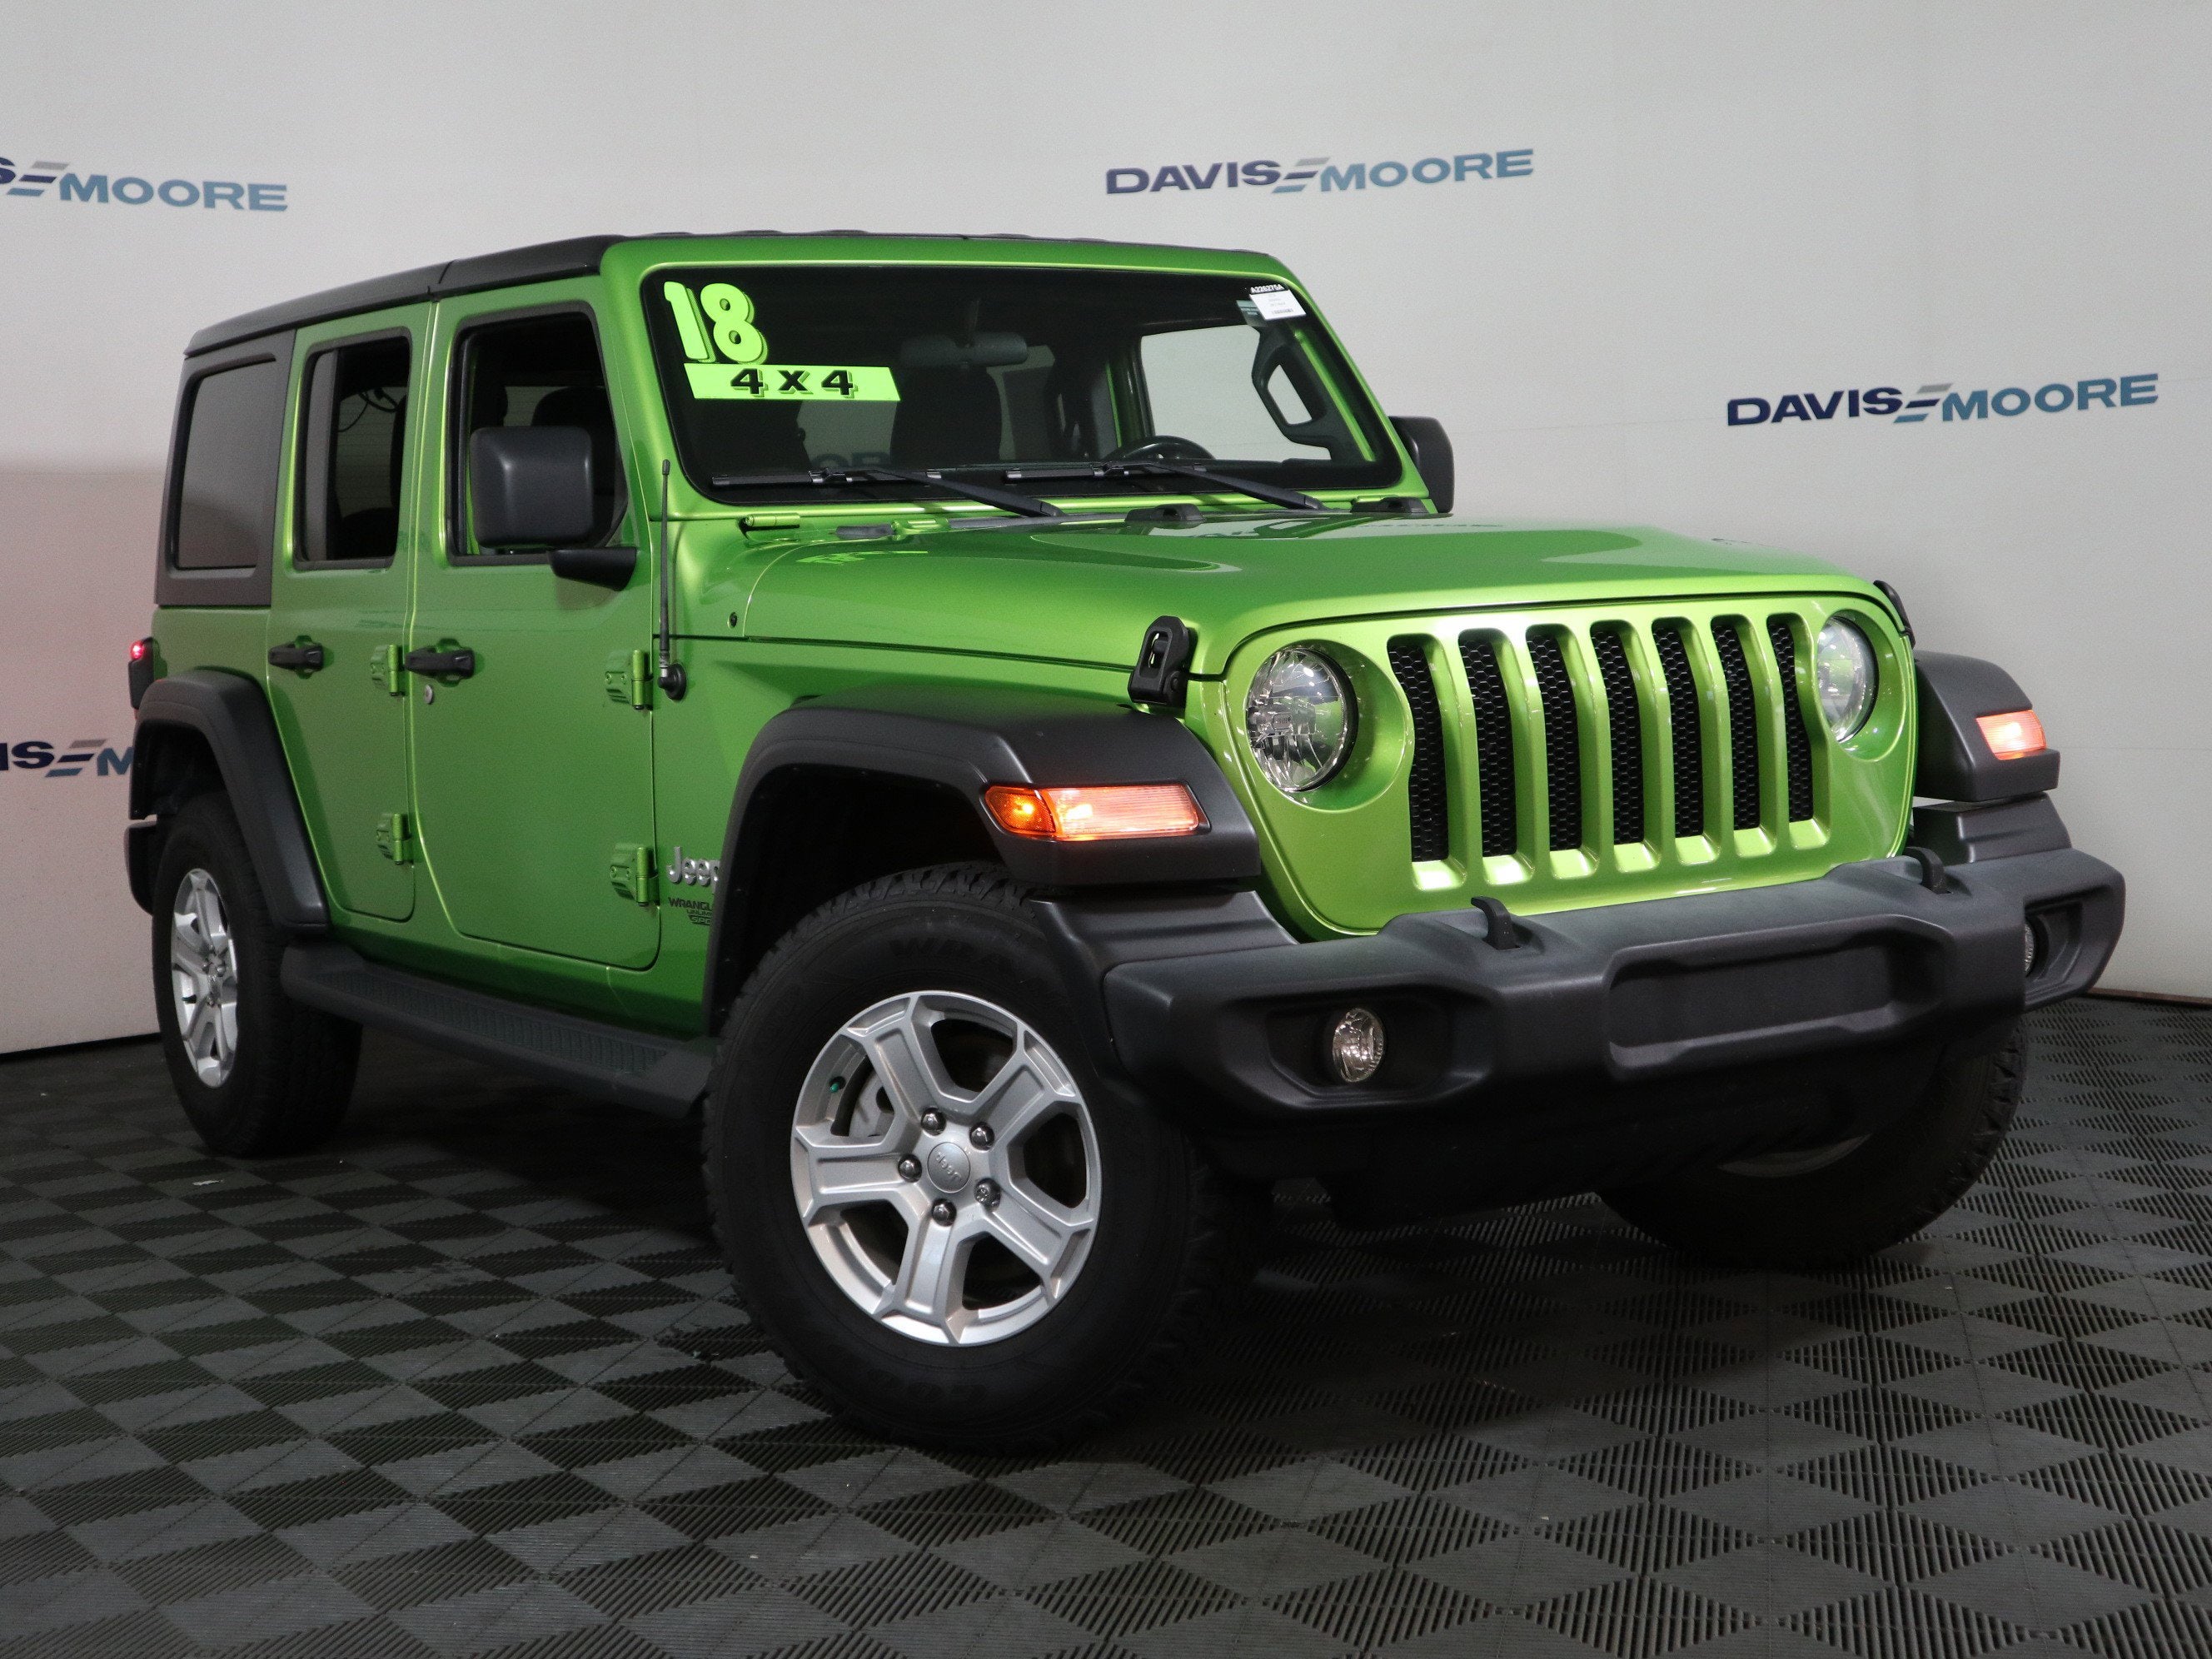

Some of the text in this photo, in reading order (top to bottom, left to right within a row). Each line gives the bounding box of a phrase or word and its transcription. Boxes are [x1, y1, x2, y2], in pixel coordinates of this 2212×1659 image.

[59, 172, 288, 212] MOORE
[1106, 148, 1534, 194] DAVIS MOORE
[664, 281, 768, 365] 18
[1727, 373, 2159, 426] DAVIS MOORE
